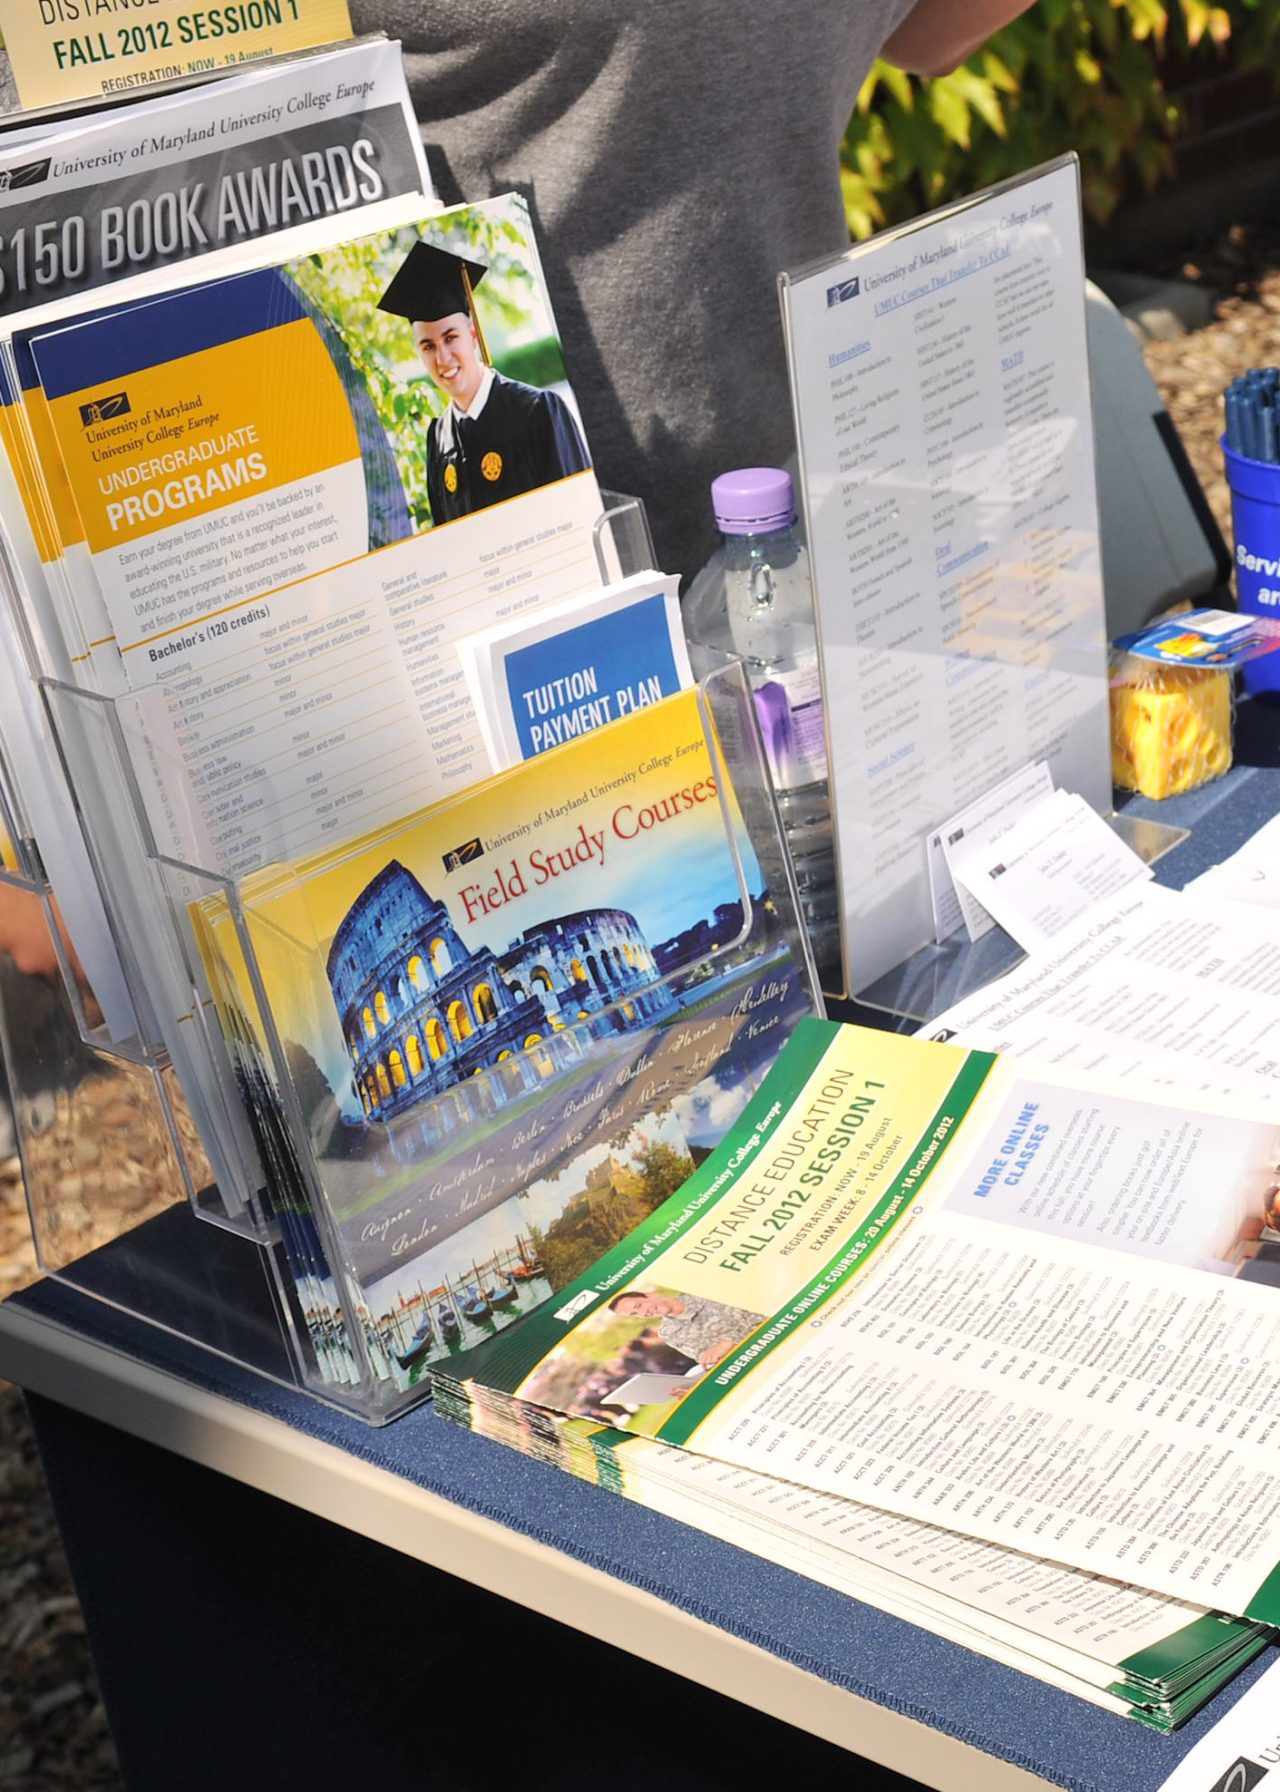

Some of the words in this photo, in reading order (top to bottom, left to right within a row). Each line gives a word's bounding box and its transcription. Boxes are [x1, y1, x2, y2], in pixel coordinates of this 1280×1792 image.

[52, 32, 116, 70] FALL
[117, 20, 173, 56] 2012
[176, 0, 282, 44] SESSION
[287, 0, 298, 20] 1
[187, 57, 215, 73] NOW
[224, 53, 237, 65] 19
[53, 149, 127, 178] University
[130, 139, 147, 159] of
[150, 121, 216, 154] Maryland
[220, 105, 284, 134] University
[286, 92, 332, 114] College
[336, 81, 375, 100] Europe
[101, 183, 209, 270] BOOK
[217, 139, 384, 241] AWARDS
[85, 419, 139, 444] University
[140, 410, 152, 426] of
[153, 394, 203, 422] Maryland
[91, 437, 144, 463] University
[145, 425, 185, 444] College
[187, 413, 220, 431] Europe
[97, 424, 260, 495] UNDERGRADUATE
[105, 452, 268, 532] PROGRAMS
[148, 631, 206, 663] Bachelor's
[206, 620, 229, 641] (120
[230, 605, 270, 630] credits)
[523, 666, 598, 719] TUITION
[530, 694, 611, 754] PAYMENT
[616, 675, 664, 718] PLAN
[484, 823, 531, 852] University
[532, 812, 543, 828] of
[543, 790, 590, 822] Maryland
[589, 770, 637, 799] University
[637, 754, 673, 775] College
[675, 739, 704, 758] Europe
[457, 859, 528, 924] Field
[529, 824, 605, 886] Study
[611, 776, 718, 840] Courses
[755, 1101, 782, 1133] Europe
[932, 1116, 955, 1140] 2012
[682, 1183, 776, 1265] DISTANCE
[763, 1069, 855, 1181] EDUCATION
[719, 1235, 775, 1272] FALL
[762, 1190, 812, 1231] 2012
[799, 1096, 876, 1187] SESSION
[864, 1080, 885, 1089] 1
[727, 1133, 761, 1168] College
[908, 1139, 940, 1177] October
[973, 1158, 1008, 1198] MORE
[999, 1102, 1039, 1155] ONLINE
[1004, 1123, 1050, 1187] CLASSES
[687, 1168, 734, 1214] University
[779, 1195, 838, 1256] REGISTRATION:
[834, 1167, 858, 1193] NOW
[856, 1150, 870, 1161] 19
[864, 1117, 892, 1150] August
[809, 1221, 839, 1252] EXAM
[831, 1198, 860, 1224] WEEK:
[864, 1172, 878, 1182] 14
[872, 1135, 903, 1171] October
[901, 1177, 916, 1188] 14
[648, 1209, 694, 1246] Maryland
[864, 1226, 880, 1238] 20
[874, 1195, 904, 1227] August
[594, 1254, 646, 1291] University
[642, 1243, 655, 1255] of
[824, 1238, 870, 1283] COURSES:
[792, 1282, 830, 1314] ONLINE
[714, 1313, 798, 1385] UNDERGRADUATE
